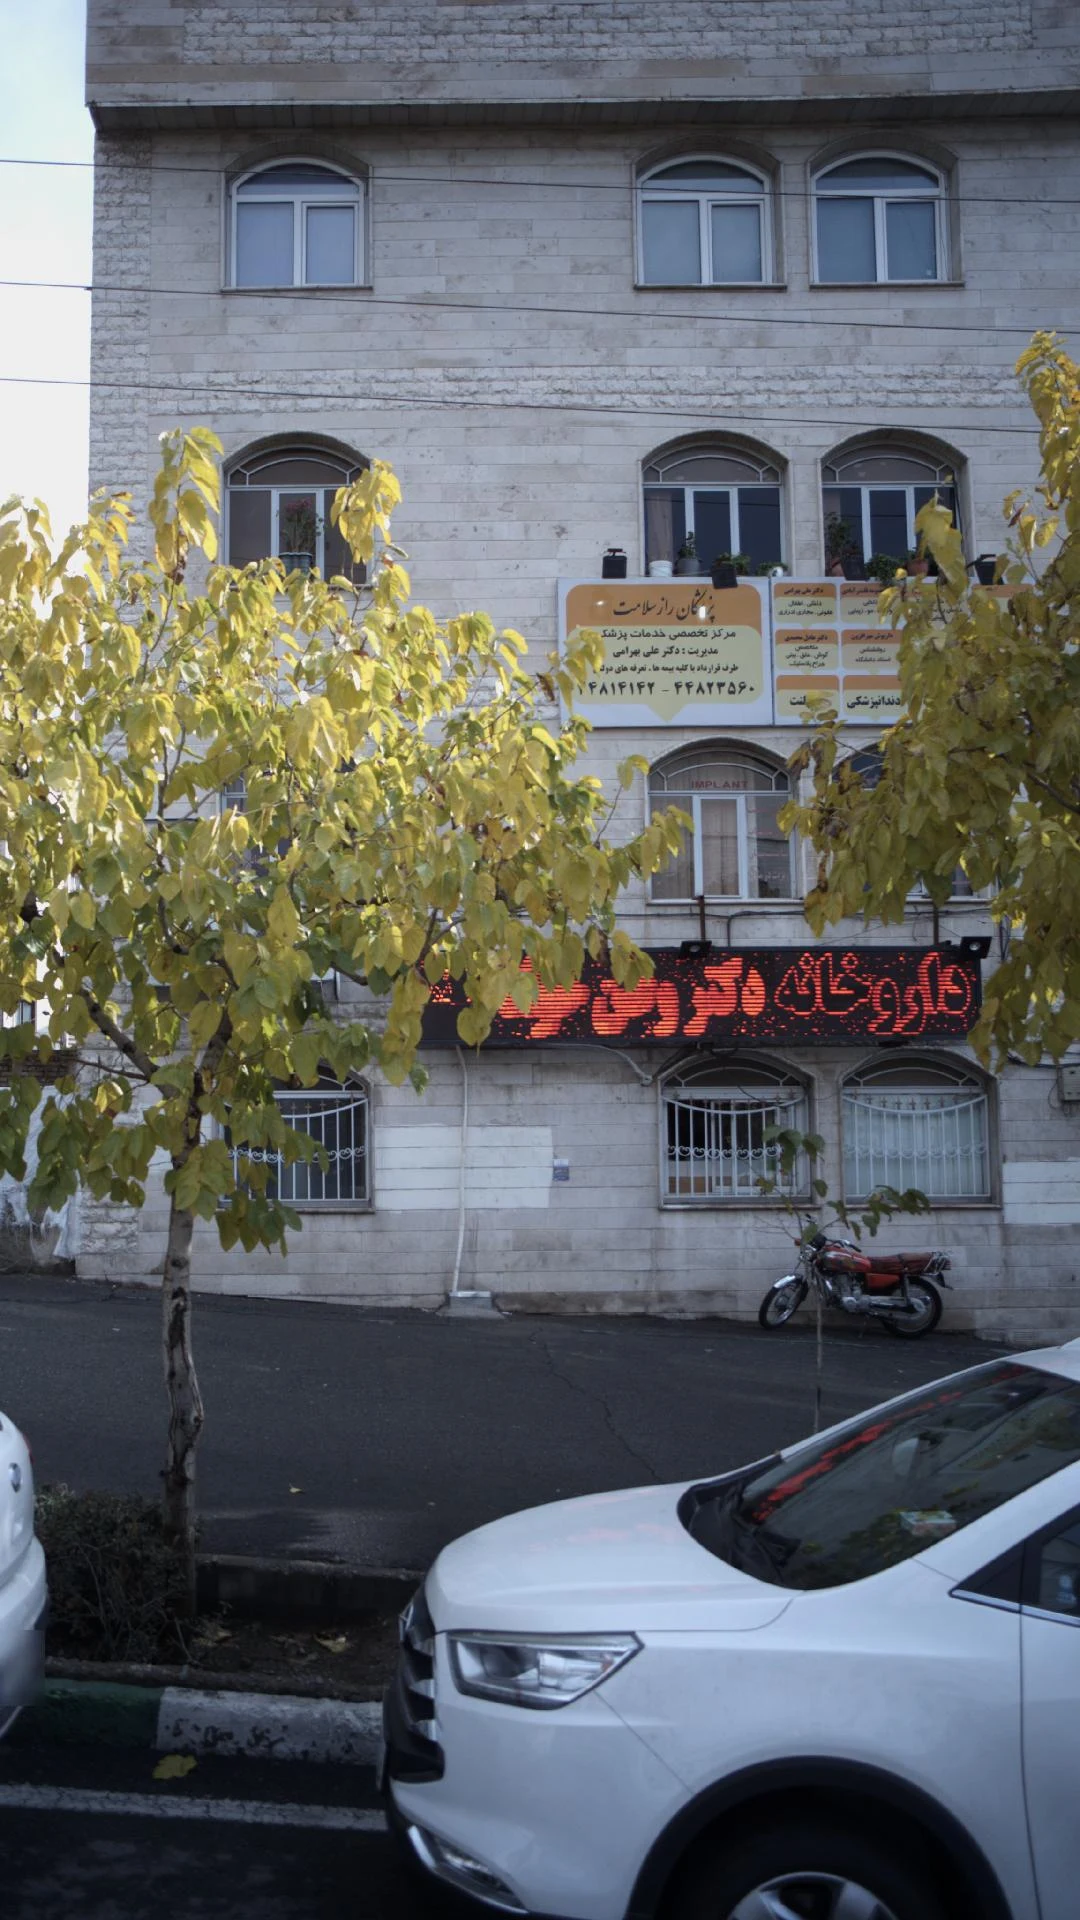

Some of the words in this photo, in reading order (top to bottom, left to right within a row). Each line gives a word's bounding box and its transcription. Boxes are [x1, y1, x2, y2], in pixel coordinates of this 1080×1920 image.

[613, 600, 656, 616] سلامت
[601, 629, 628, 641] پزشک
[630, 629, 667, 640] خدمات
[669, 628, 709, 641] تخصصی
[712, 629, 737, 641] مرکز
[612, 646, 641, 658] بهرامی
[643, 645, 659, 658] علی
[661, 645, 680, 657] دکتر
[687, 646, 719, 658] مدیریت
[697, 664, 721, 673] قرارداد
[721, 665, 739, 673] طرف
[674, 681, 755, 696] ۴۴۸۲۳۵۶۰
[847, 696, 900, 709] دندانپزشکی
[692, 780, 748, 788] IMPLANT
[774, 951, 972, 1036] داروخانه
